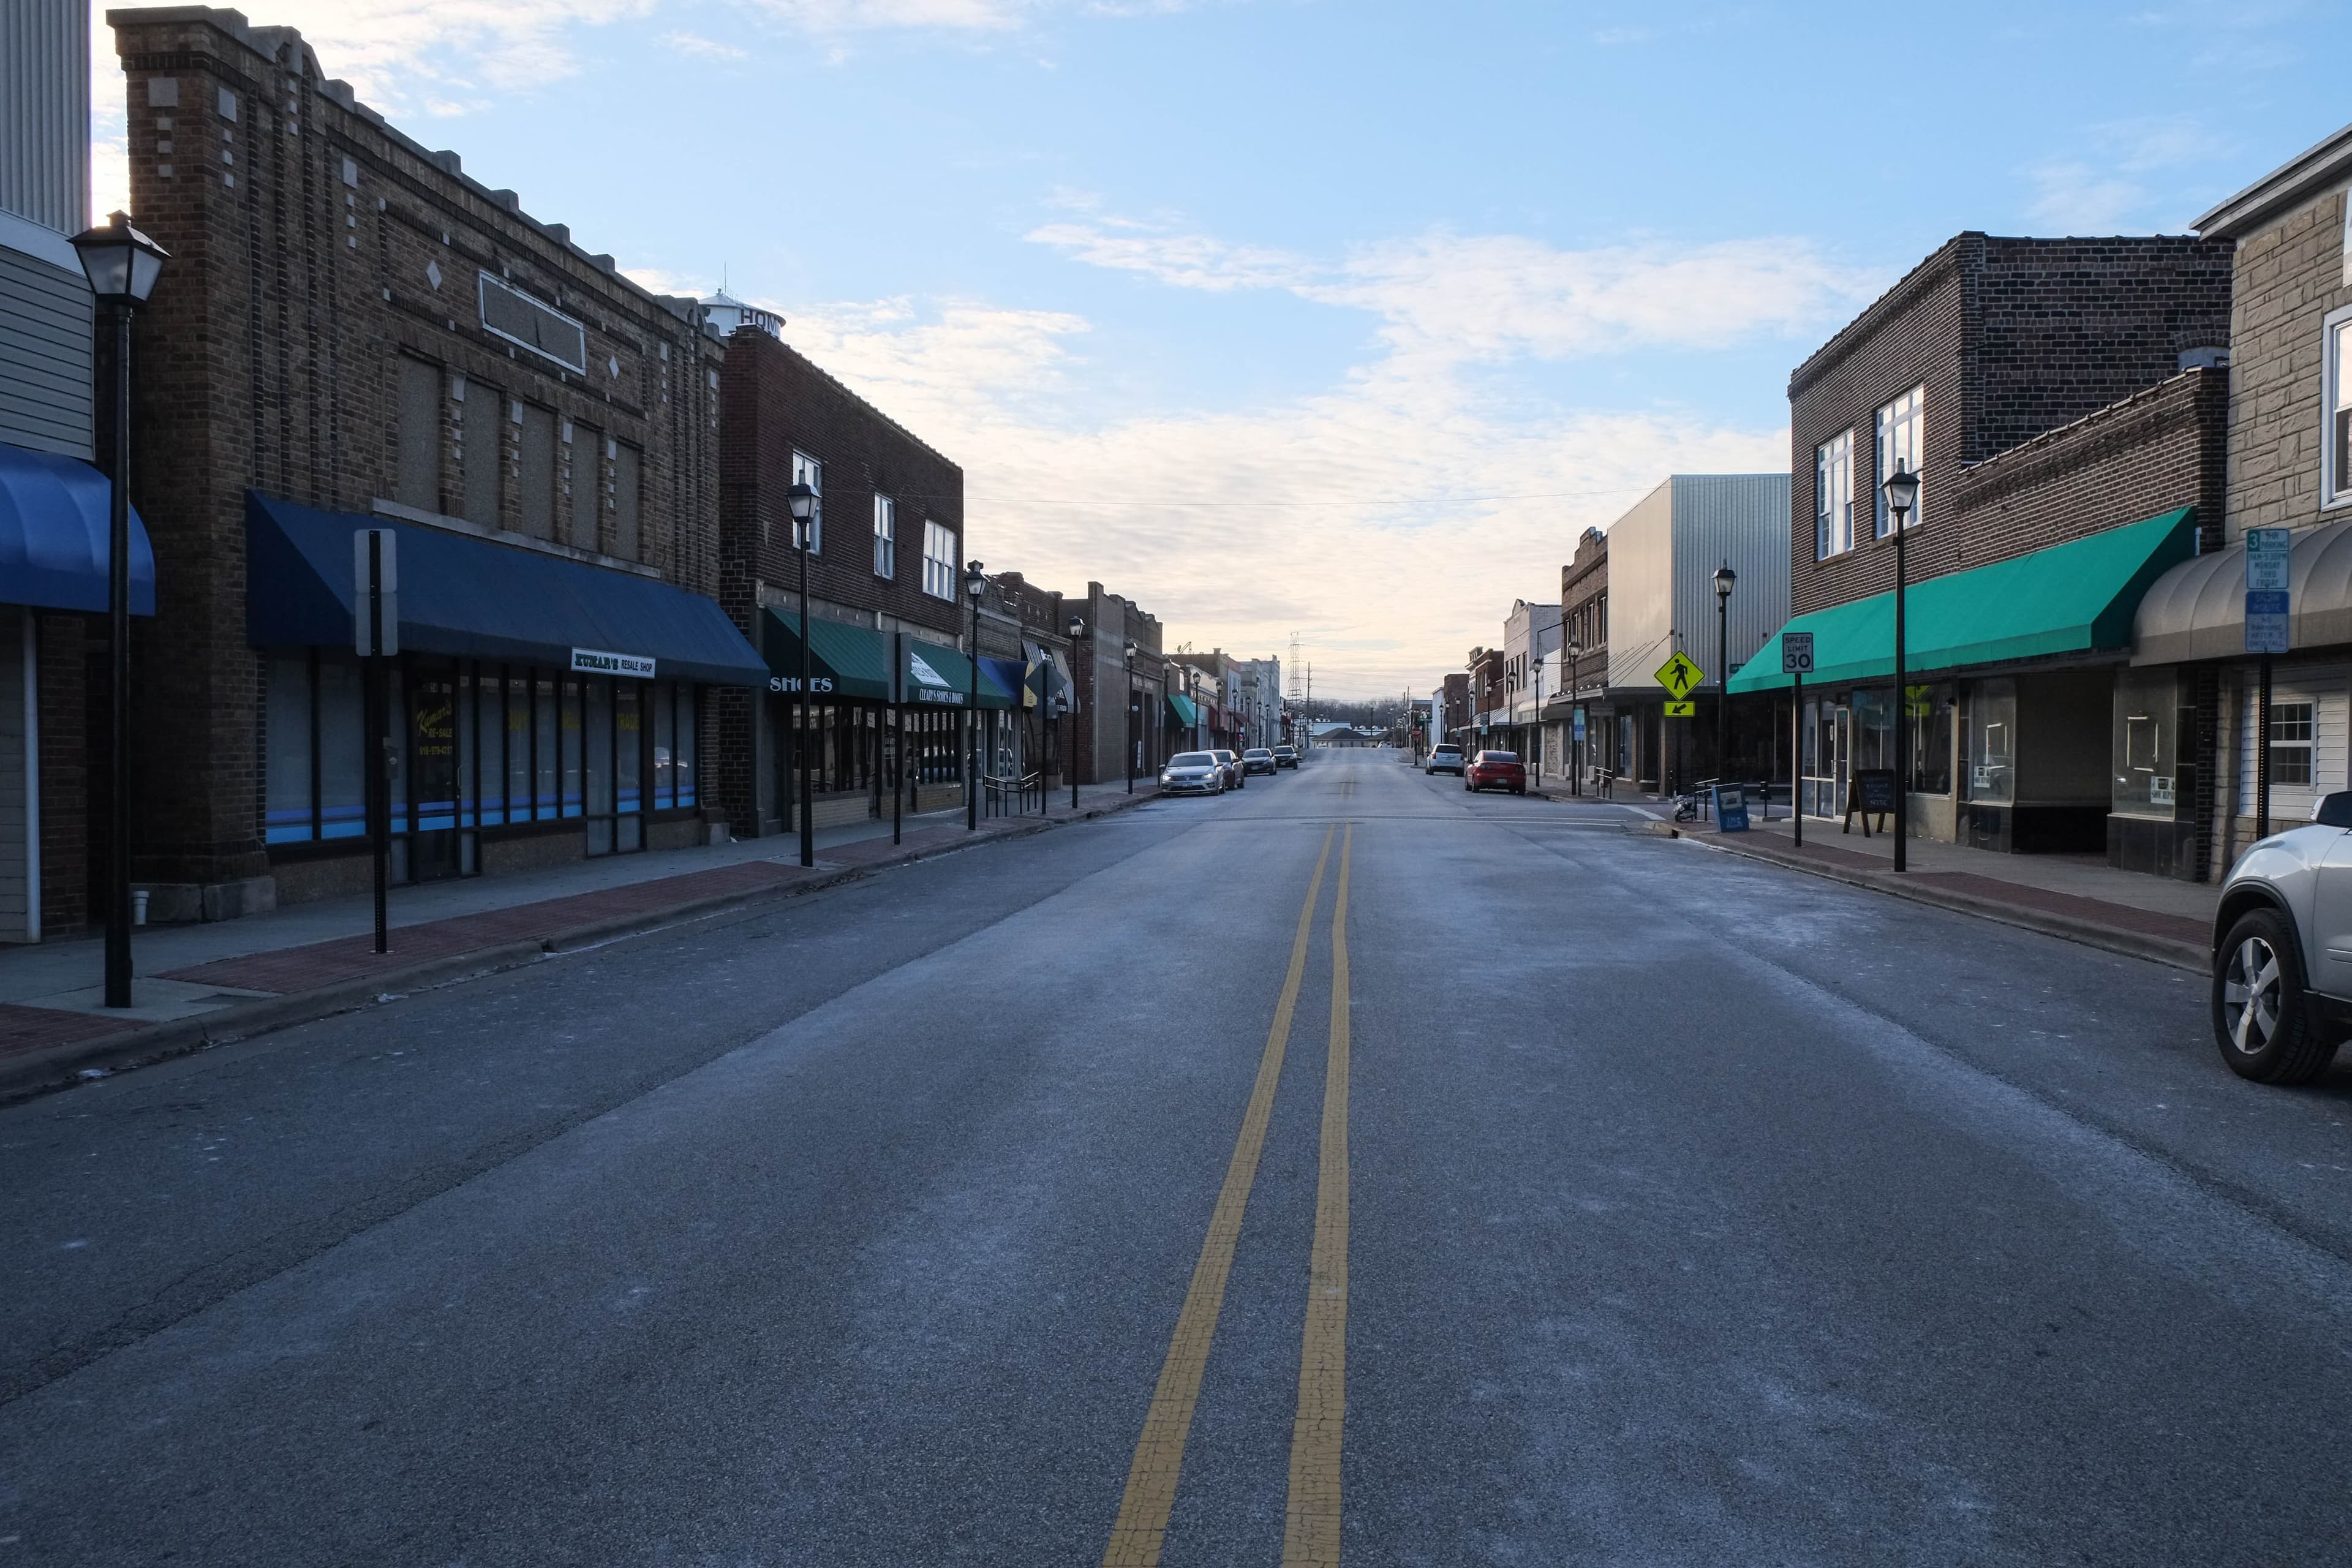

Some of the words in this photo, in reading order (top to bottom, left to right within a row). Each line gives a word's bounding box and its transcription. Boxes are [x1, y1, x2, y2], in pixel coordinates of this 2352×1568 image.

[2249, 533, 2258, 549] 3
[2252, 603, 2282, 611] ROUTE
[575, 653, 619, 671] KUMAR'S
[621, 659, 638, 671] RESALE
[640, 662, 652, 673] SHOP
[1785, 654, 1811, 668] 30
[937, 690, 949, 703] SHOES
[952, 692, 963, 705] BOOTS
